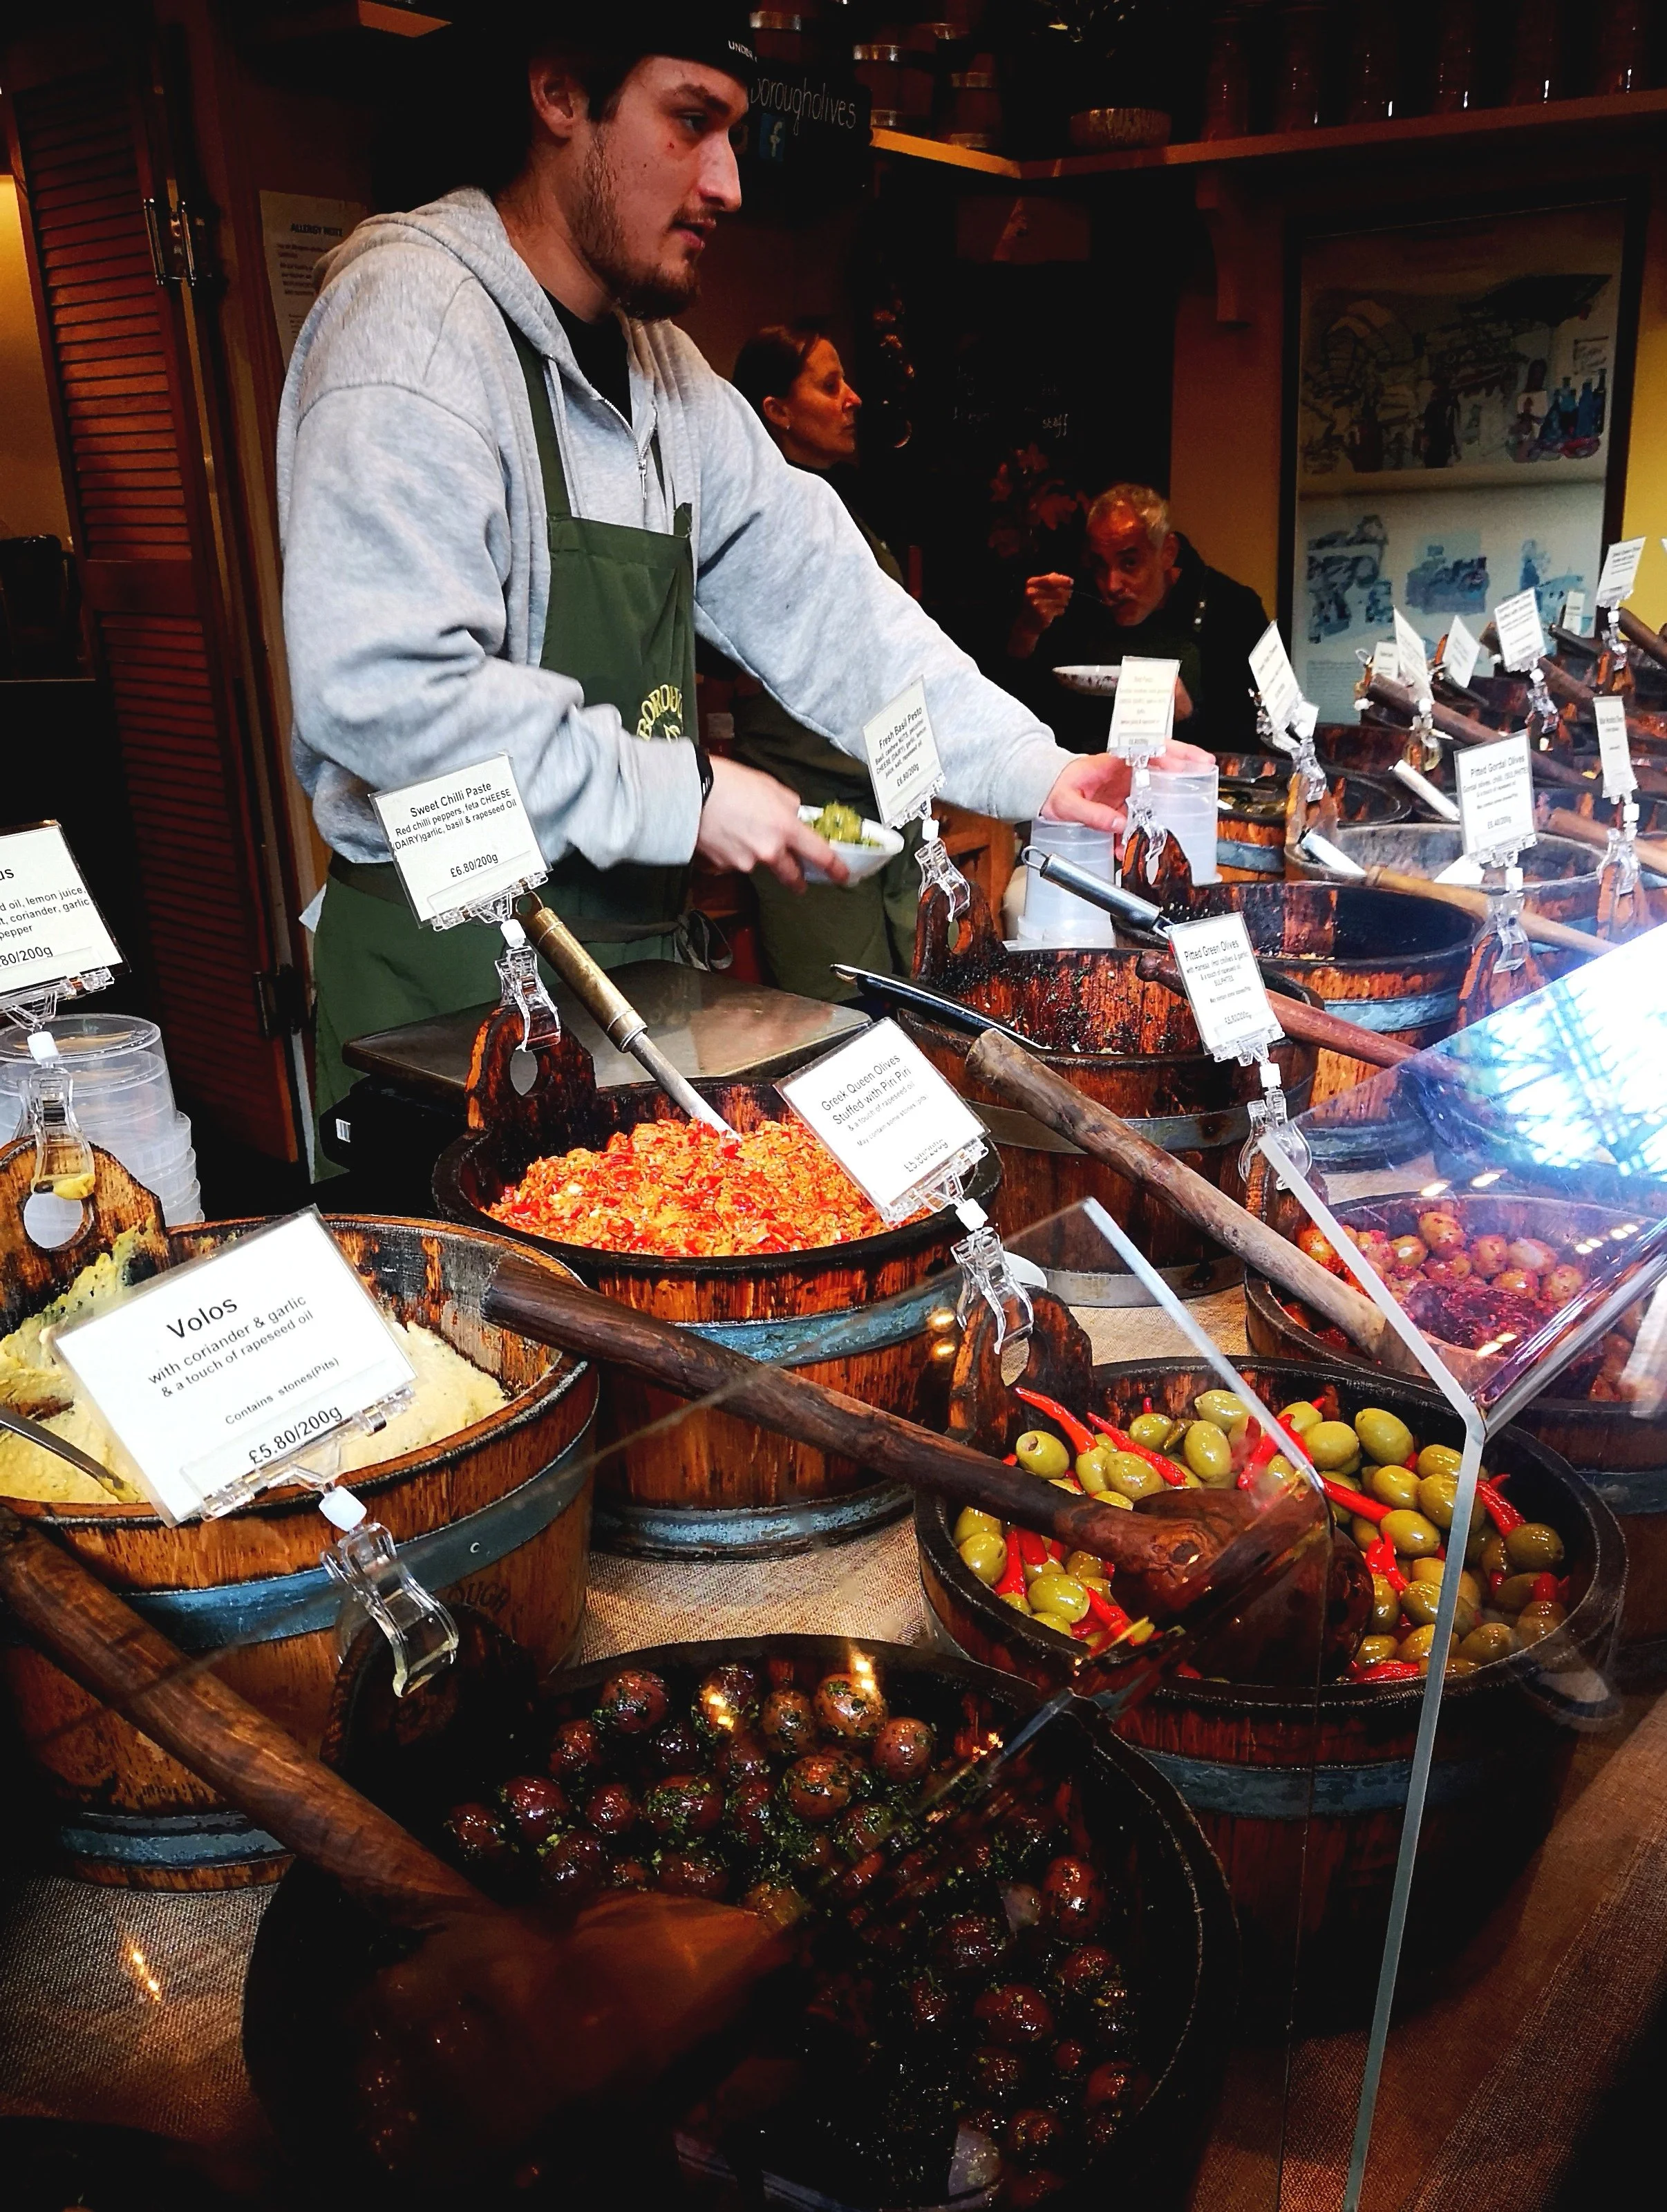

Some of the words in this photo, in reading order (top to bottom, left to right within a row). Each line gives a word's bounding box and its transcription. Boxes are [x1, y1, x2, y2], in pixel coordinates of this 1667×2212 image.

[879, 730, 894, 749] Fresh
[894, 718, 907, 736] Basil
[908, 707, 922, 723] Pesto
[396, 824, 411, 836] Red
[413, 817, 431, 830] chilli
[465, 801, 479, 811] feta
[480, 788, 511, 806] CHEESE
[411, 801, 439, 817] Sweet
[441, 791, 464, 806] Chilli
[467, 782, 491, 797] Paste
[446, 819, 464, 831] basil
[473, 804, 505, 822] rapeseed
[507, 799, 517, 808] Oil
[451, 853, 498, 877] £6.80/200g
[10, 905, 62, 923] coriander,
[63, 898, 90, 912] garlic
[26, 892, 57, 905] lemon
[59, 887, 86, 900] juice,
[1185, 949, 1202, 961] Pitted
[1203, 945, 1219, 957] Green
[1221, 940, 1239, 952] Olives
[822, 1090, 848, 1111] Greek
[847, 1072, 875, 1094] Queen
[874, 1055, 901, 1075] Olives
[833, 1102, 864, 1125] Stuffed
[865, 1088, 883, 1104] with
[880, 1079, 897, 1092] Piri
[895, 1066, 912, 1081] Piri
[860, 1110, 876, 1124] touch
[882, 1087, 906, 1108] rapeseed
[907, 1082, 915, 1090] oil
[857, 1136, 869, 1147] May
[887, 1114, 900, 1126] some
[900, 1104, 916, 1119] stones
[149, 1361, 181, 1385] with
[184, 1323, 250, 1366] coriander
[254, 1316, 265, 1328] &
[268, 1294, 307, 1324] garlic
[166, 1298, 238, 1339] Volos
[162, 1386, 173, 1398] &
[176, 1380, 185, 1391] a
[187, 1359, 223, 1386] touch
[225, 1350, 238, 1366] of
[241, 1321, 296, 1361] rapeseed
[299, 1310, 313, 1325] oil
[225, 1393, 274, 1426] Contains
[278, 1357, 339, 1396] stones(Pits)
[248, 1404, 343, 1464] £5.80/200g
